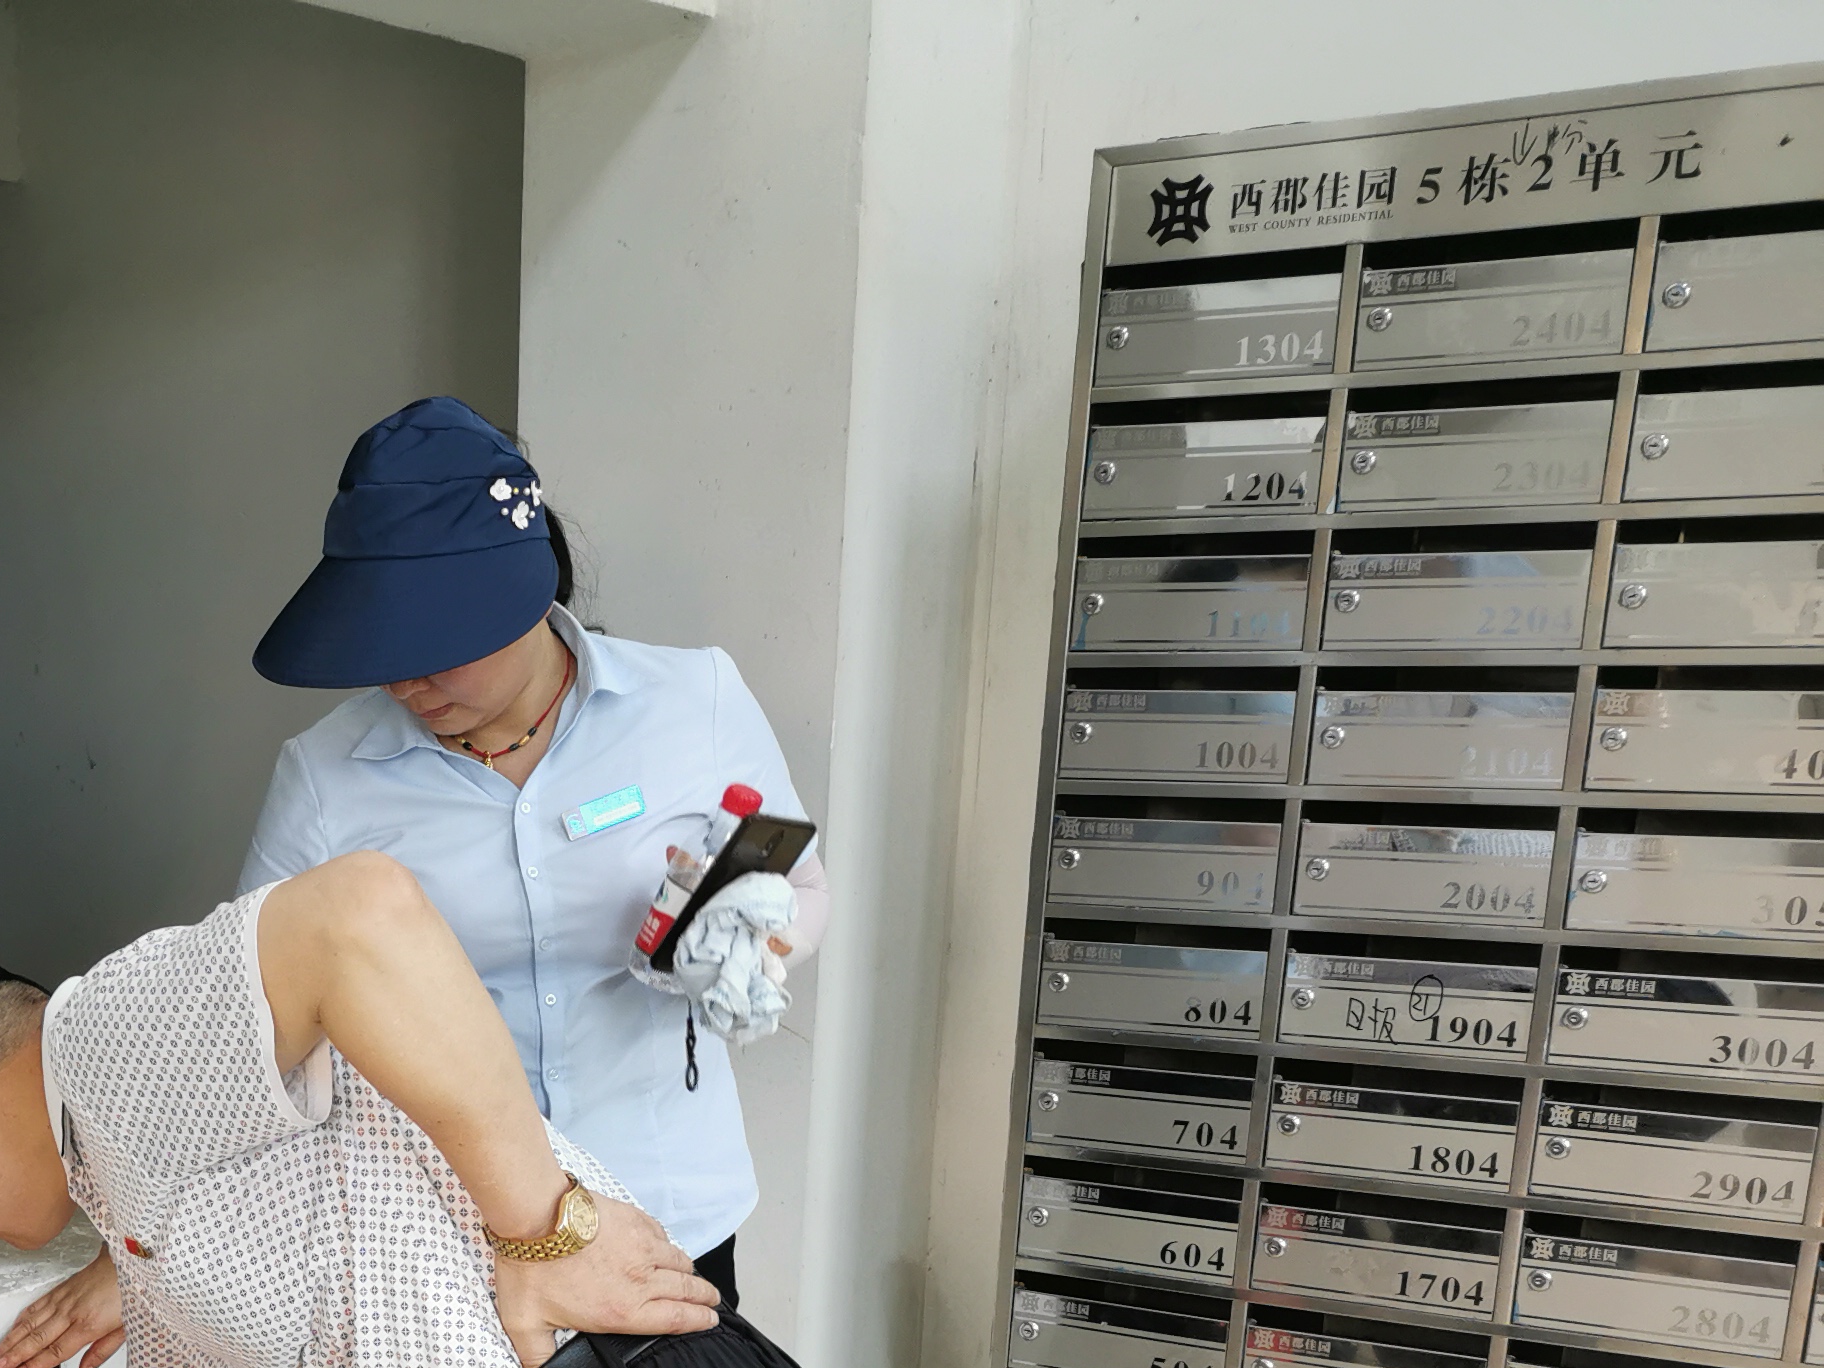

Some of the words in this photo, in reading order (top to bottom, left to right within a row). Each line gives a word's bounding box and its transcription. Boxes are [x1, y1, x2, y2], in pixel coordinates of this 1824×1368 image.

[1228, 222, 1259, 233] WEST
[1263, 216, 1312, 230] COUNTY
[1317, 209, 1394, 227] RESIDENTIAL
[1510, 309, 1612, 347] 2404
[1235, 329, 1324, 366] 1304
[1221, 470, 1308, 502] 1204
[1492, 460, 1591, 492] 2304
[1477, 605, 1573, 635] 2204
[1195, 741, 1280, 770] 1004
[1440, 881, 1536, 915] 2004
[1184, 996, 1252, 1026] 804
[1425, 1014, 1517, 1048] 1904
[1708, 1035, 1816, 1071] 3004
[1172, 1119, 1238, 1150] 704
[1408, 1144, 1498, 1179] 1804
[1690, 1170, 1795, 1209] 2904
[1160, 1240, 1225, 1272] 604
[1395, 1270, 1484, 1306] 1704
[1667, 1305, 1771, 1344] 2804
